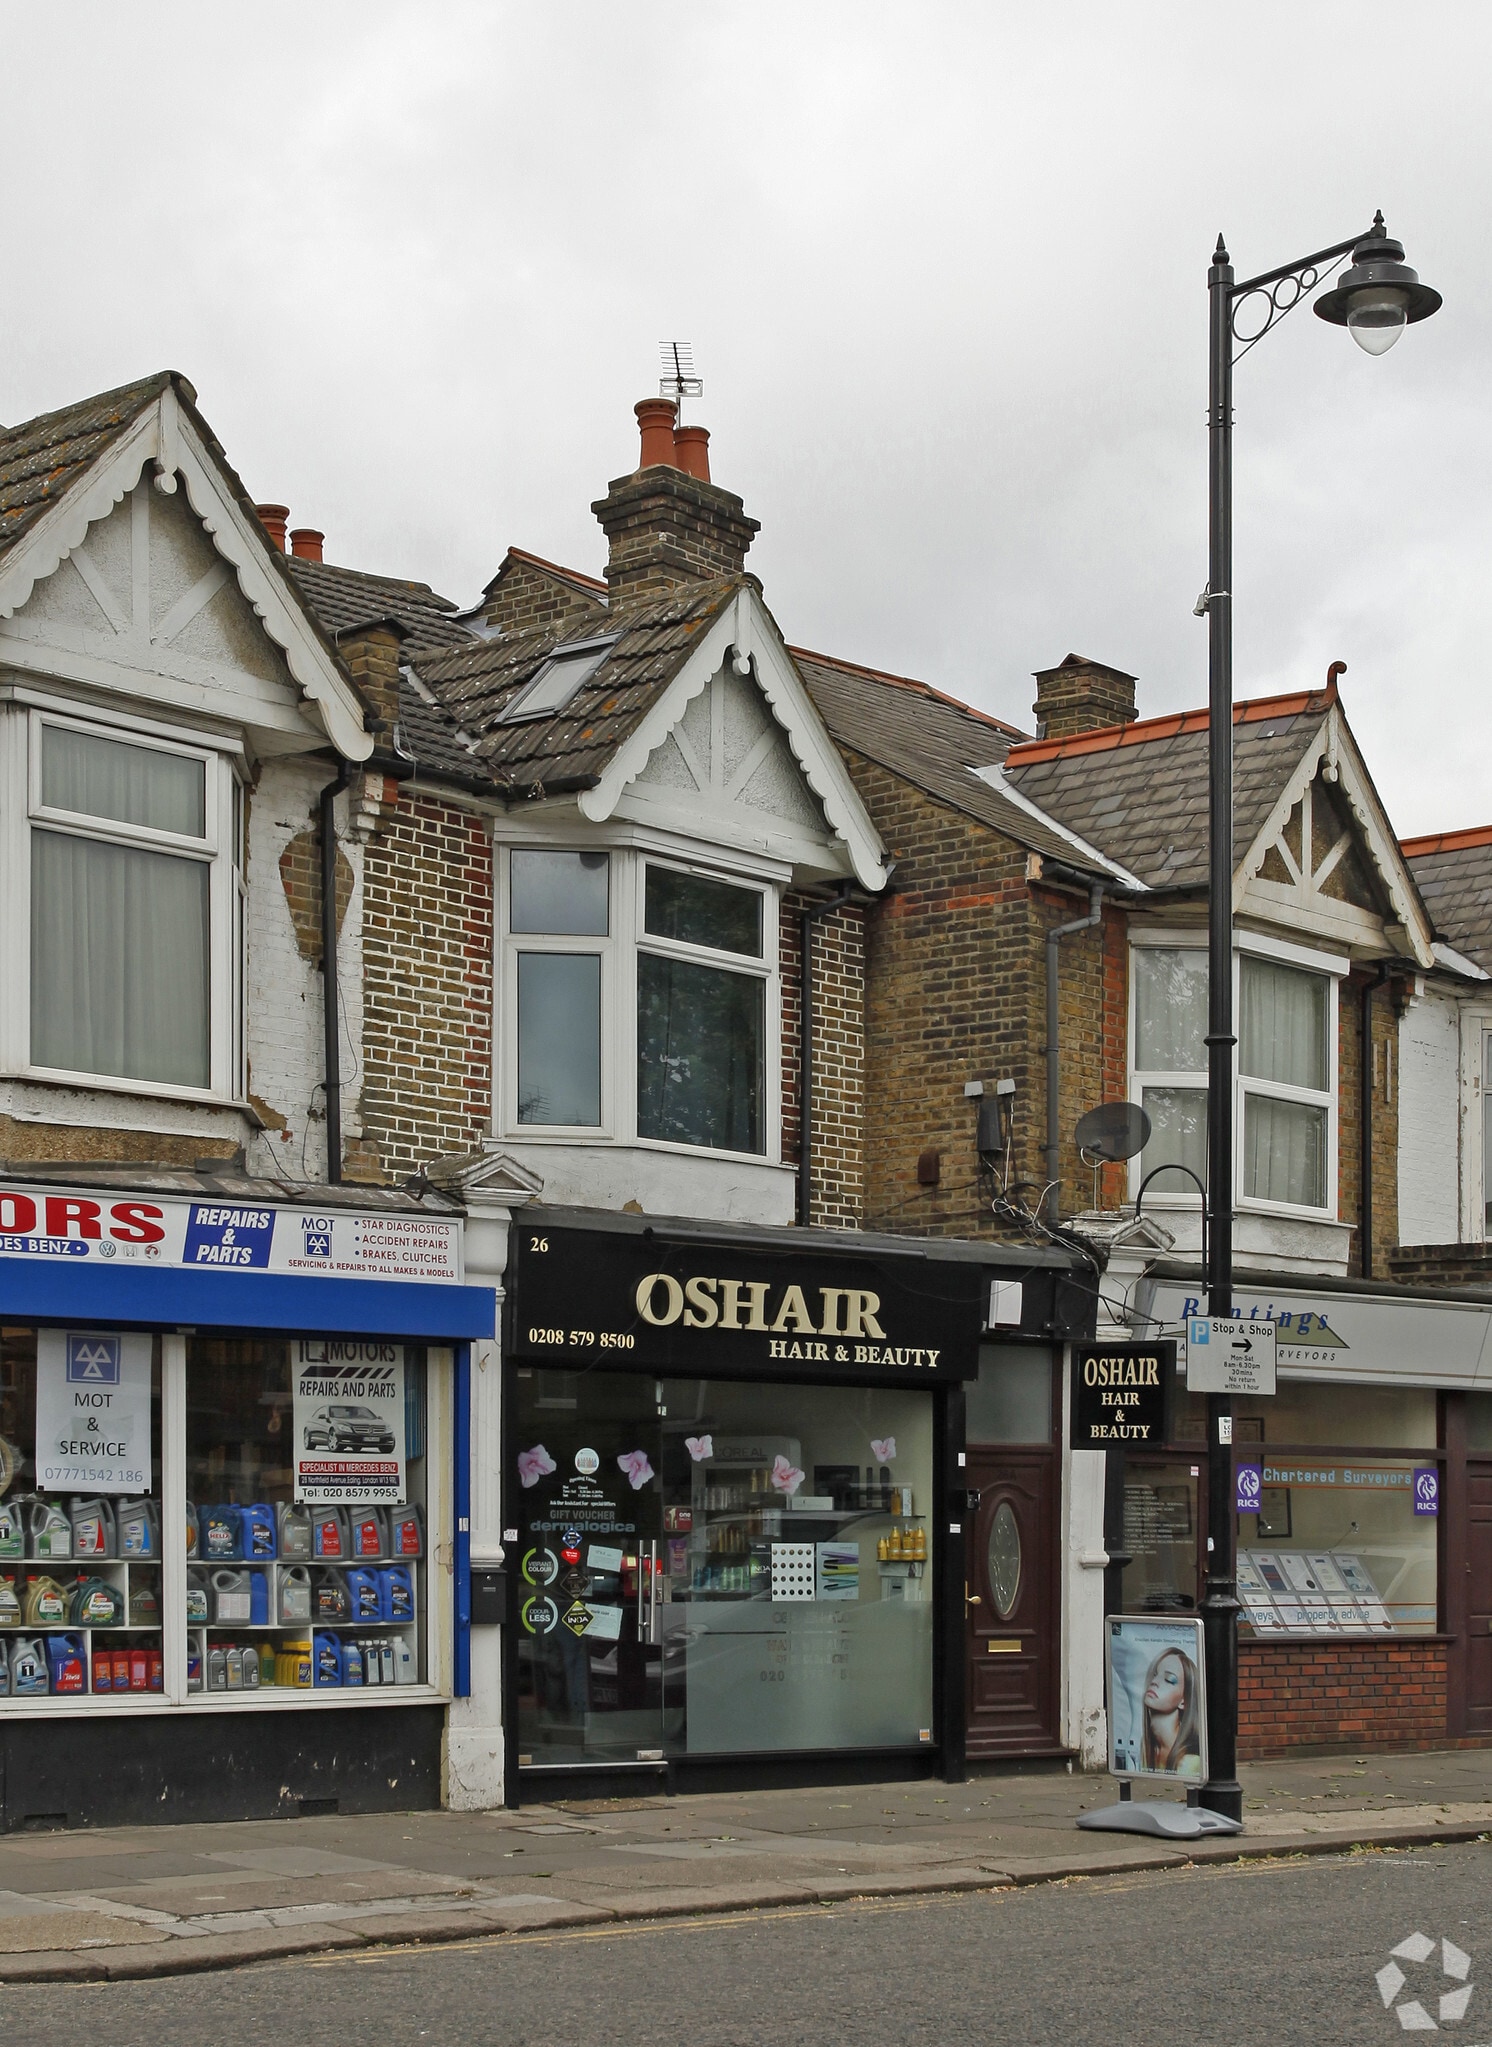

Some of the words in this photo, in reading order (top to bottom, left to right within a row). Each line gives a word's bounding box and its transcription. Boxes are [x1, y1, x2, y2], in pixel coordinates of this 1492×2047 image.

[195, 1208, 271, 1229] REPAIRS
[301, 1217, 335, 1231] MOT
[362, 1219, 384, 1230] STAR
[387, 1221, 450, 1235] DIAGNOSTICS
[221, 1228, 237, 1245] &
[362, 1235, 410, 1247] ACCIDENT
[413, 1238, 448, 1250] REPAIRS
[28, 1239, 71, 1254] BENZ
[530, 1236, 549, 1253] 26
[196, 1245, 253, 1264] PARTS
[362, 1250, 400, 1262] BRAKES,
[403, 1252, 448, 1264] CLUTCHES
[288, 1259, 327, 1269] SERVICING
[337, 1262, 366, 1272] REPAIRS
[368, 1265, 377, 1273] TO
[379, 1265, 391, 1274] ALL
[394, 1266, 418, 1275] MAKES
[420, 1268, 425, 1276] &
[427, 1268, 455, 1278] MODELS
[636, 1273, 887, 1339] OSHAIR
[1180, 1297, 1329, 1336] Bntings
[1212, 1323, 1235, 1335] Stop
[1238, 1325, 1245, 1334] &
[1249, 1325, 1273, 1337] Shop
[528, 1328, 564, 1345] 0208
[569, 1331, 595, 1347] 579
[600, 1332, 635, 1349] 8500
[330, 1343, 396, 1363] MOTORS
[769, 1339, 830, 1362] HAIR
[834, 1345, 850, 1362] &
[854, 1345, 941, 1368] BEAUTY
[1278, 1349, 1336, 1361] RVEYORS
[1084, 1358, 1160, 1386] OSHAIR
[300, 1381, 339, 1397] REPAIRS
[342, 1382, 365, 1397] AND
[368, 1382, 396, 1398] PARTS
[74, 1393, 113, 1408] MOT
[1101, 1392, 1141, 1406] HAIR
[1115, 1409, 1126, 1422] &
[87, 1417, 99, 1432] &
[1090, 1425, 1151, 1439] BEAUTY
[60, 1440, 126, 1457] SERVICE
[45, 1467, 113, 1482] 07771542
[118, 1470, 143, 1483] 186
[302, 1462, 338, 1473] SPECIALIST
[339, 1463, 345, 1473] IN
[346, 1463, 379, 1473] MERCEDES
[381, 1463, 396, 1473] BENZ
[1263, 1468, 1336, 1483] Chartered
[1344, 1469, 1412, 1487] Surveyors
[302, 1488, 320, 1497] Tel:
[323, 1488, 342, 1498] 020
[345, 1488, 370, 1498] 8579
[373, 1488, 398, 1498] 9955
[1237, 1499, 1260, 1508] RICS
[1416, 1502, 1437, 1511] RICS
[549, 1510, 571, 1519] GIFT
[572, 1510, 615, 1520] VOUCHER
[530, 1521, 636, 1533] dermalogica
[1297, 1610, 1338, 1622] property
[1341, 1609, 1370, 1619] advice
